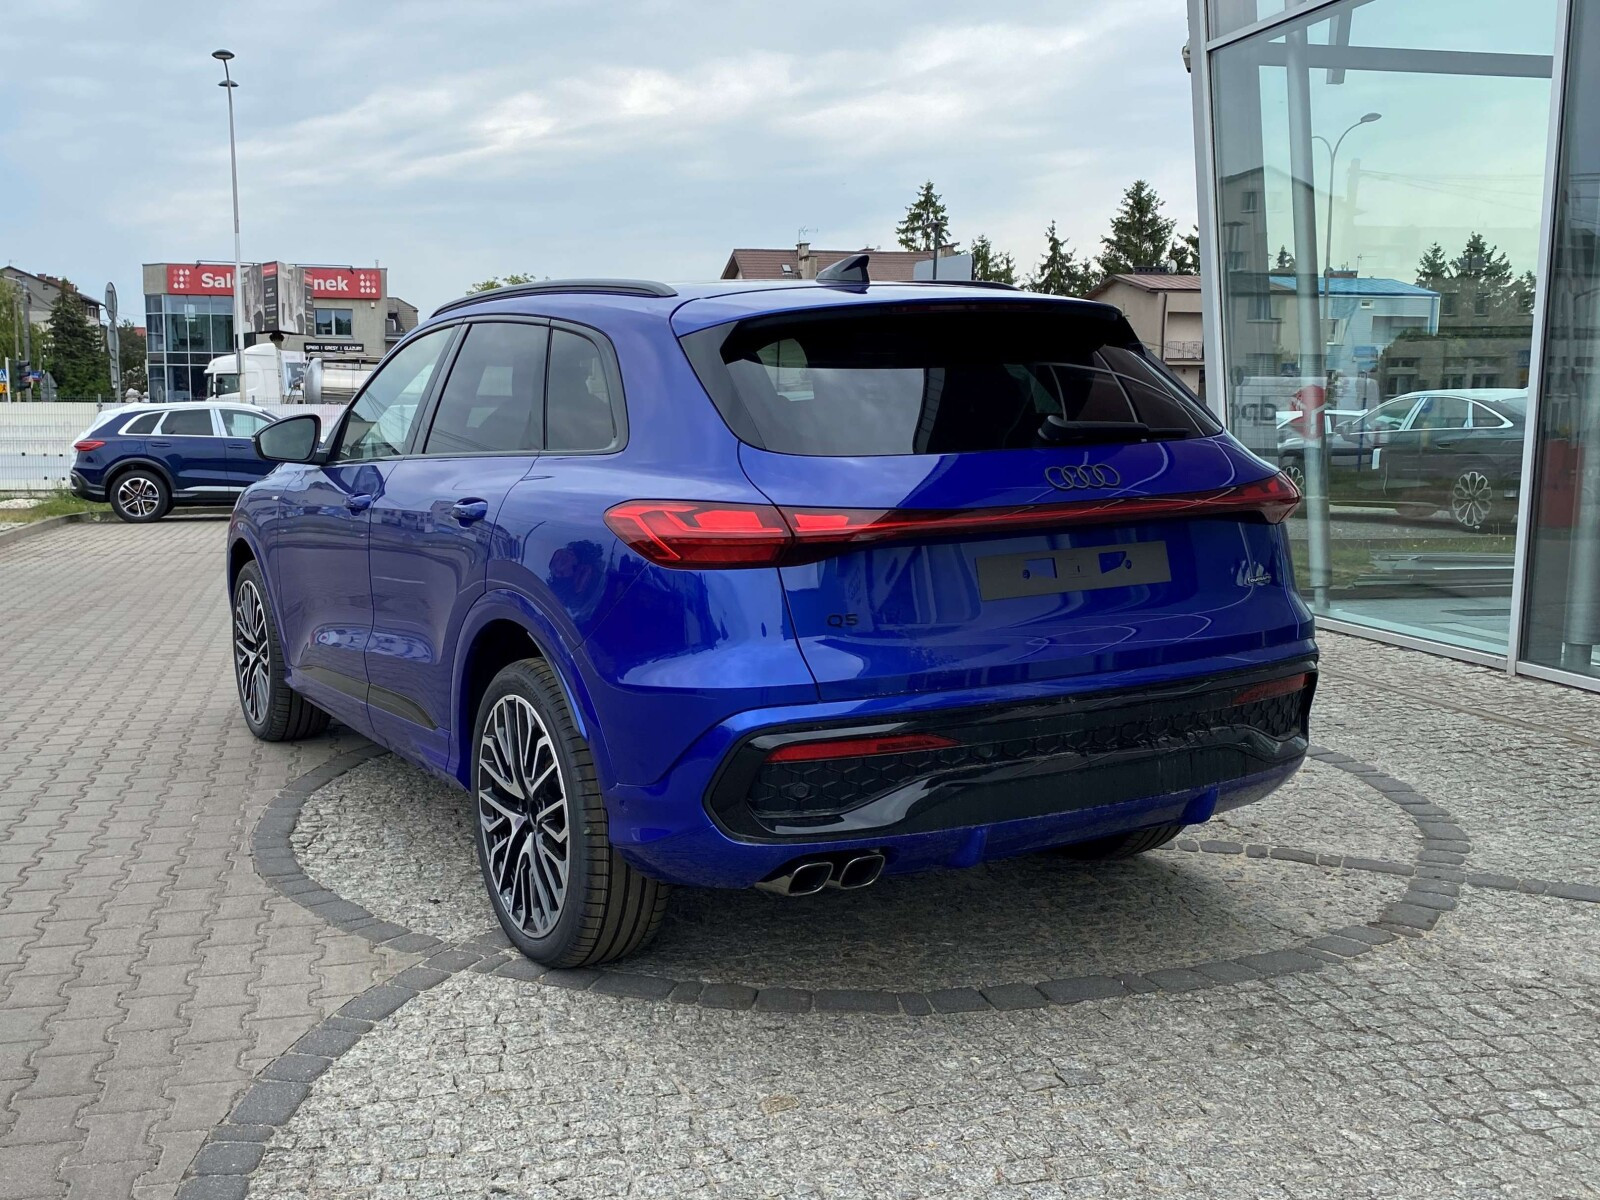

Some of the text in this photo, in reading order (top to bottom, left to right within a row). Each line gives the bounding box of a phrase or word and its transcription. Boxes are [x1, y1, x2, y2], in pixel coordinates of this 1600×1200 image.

[201, 272, 234, 288] Sal
[313, 275, 349, 291] nek
[827, 613, 858, 628] Q5
